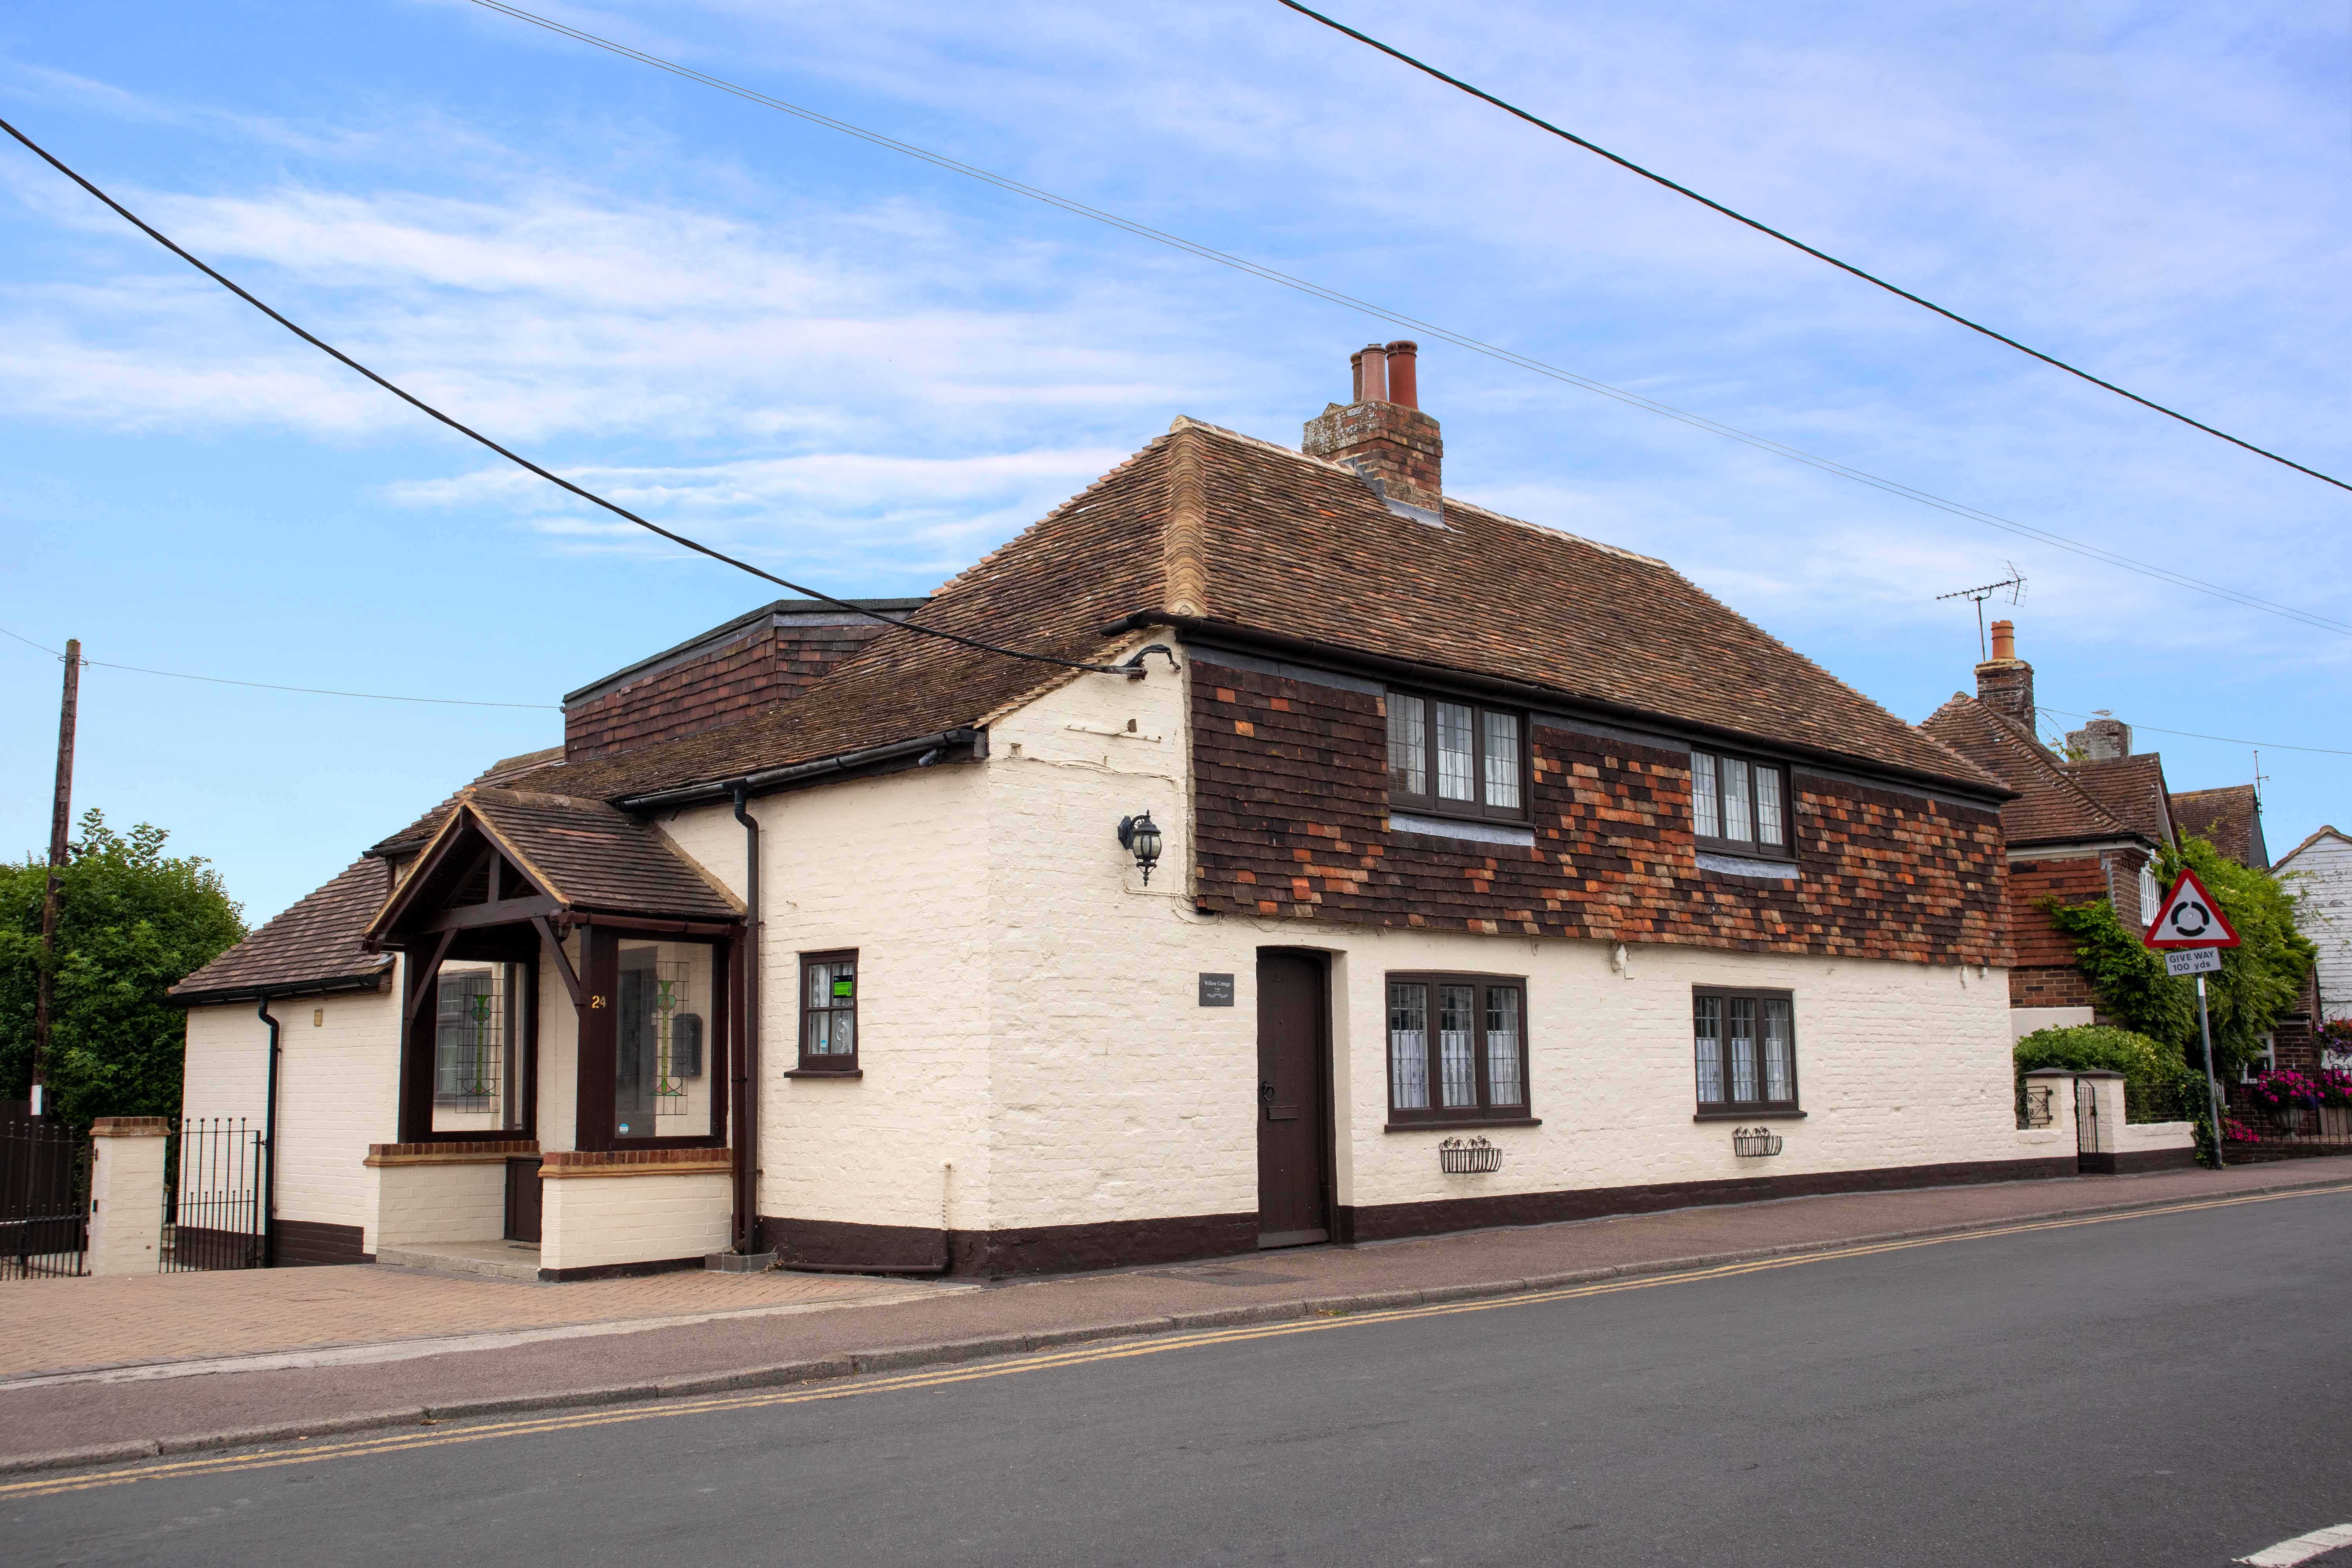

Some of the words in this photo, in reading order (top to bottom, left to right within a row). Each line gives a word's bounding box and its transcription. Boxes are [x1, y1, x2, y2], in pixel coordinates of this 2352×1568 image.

[2169, 953, 2192, 963] GIVE
[2194, 951, 2214, 960] WAY
[2173, 963, 2189, 971] 100
[2194, 961, 2210, 970] yds
[592, 995, 606, 1009] 24
